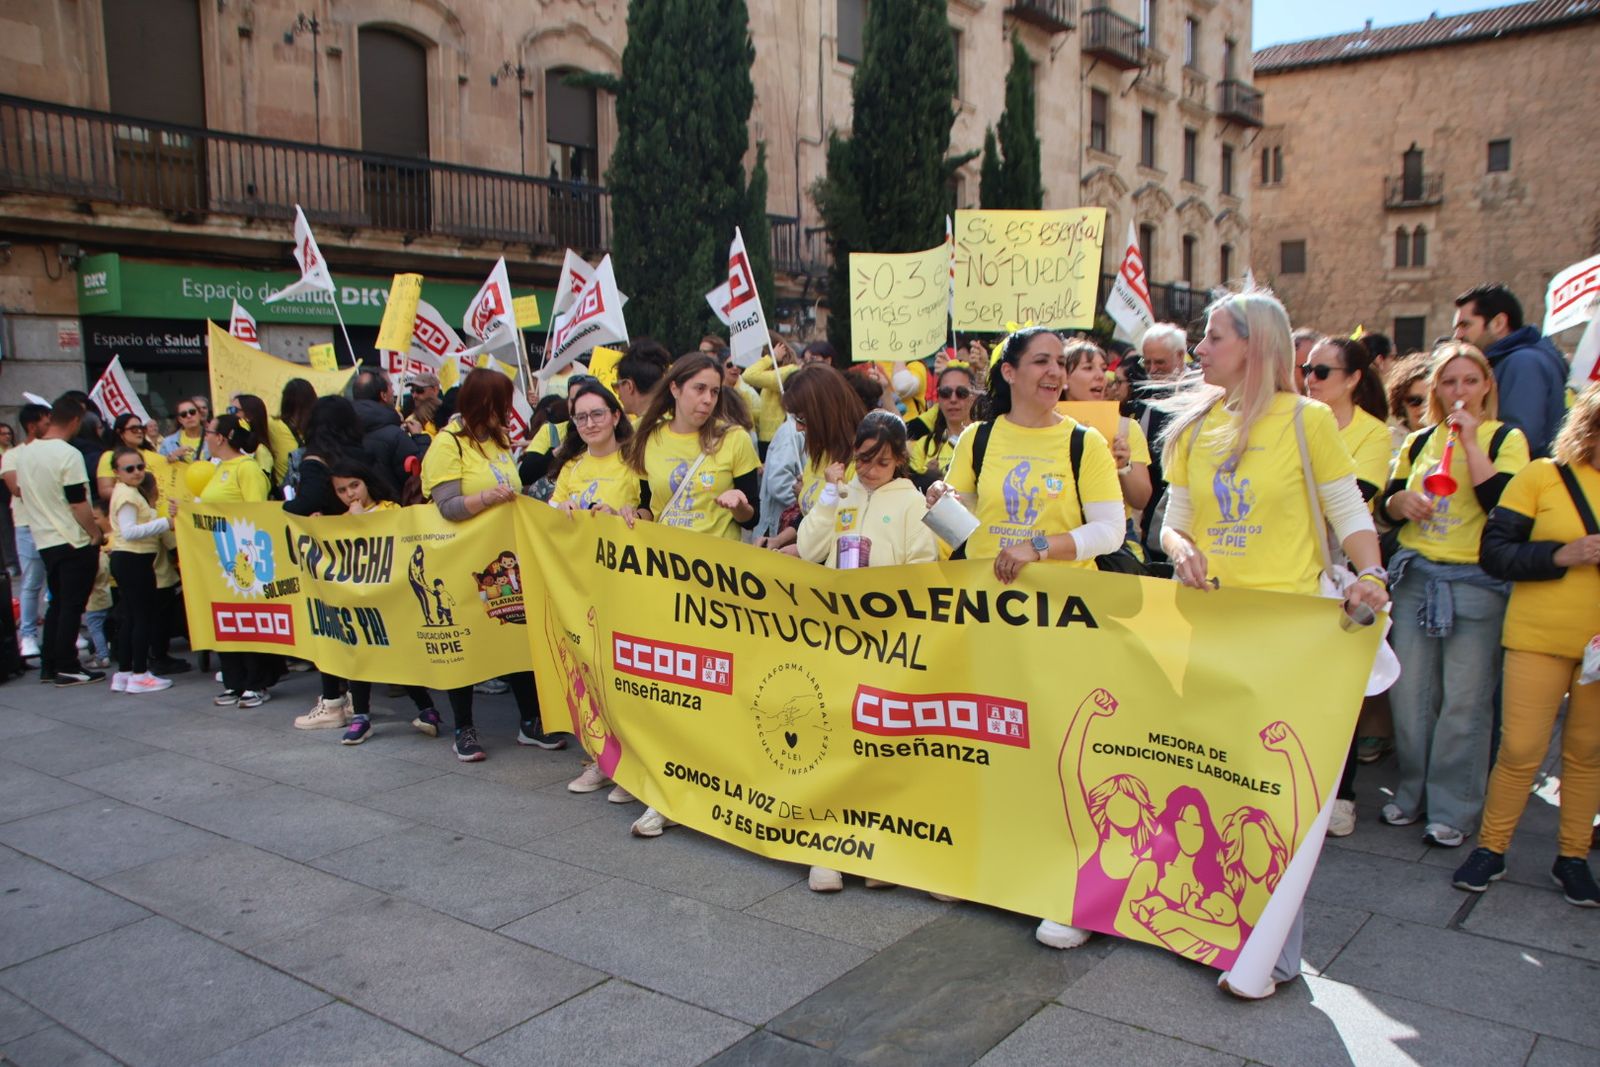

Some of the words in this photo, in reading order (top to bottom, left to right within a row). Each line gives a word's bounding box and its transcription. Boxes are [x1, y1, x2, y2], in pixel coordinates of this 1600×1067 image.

[83, 271, 107, 288] DKV
[182, 278, 253, 302] Espacio
[874, 261, 926, 299] 0-3
[270, 304, 303, 314] CENTRO
[94, 332, 144, 348] Espacio
[145, 332, 162, 347] de
[164, 333, 201, 347] Salud
[859, 328, 879, 351] de
[889, 330, 903, 351] lo
[1225, 534, 1246, 548] PIE
[322, 536, 394, 583] LUCHA
[595, 537, 766, 600] ABANDONO
[774, 579, 798, 606] Y
[810, 587, 1099, 629] VIOLENCIA
[216, 611, 290, 635] CCOO
[417, 630, 451, 641] EDUCACIÓN
[453, 628, 471, 638] 0-3
[674, 592, 927, 671] INSTITUCIONAL
[425, 642, 439, 655] EN
[440, 640, 463, 654] PIE
[615, 638, 697, 679] CCOO
[614, 676, 702, 711] enseñanza
[753, 663, 803, 707] PLATAFORMA
[806, 671, 829, 726] LABORAL
[856, 692, 979, 731] CCOO
[755, 715, 784, 770] ESCUELAS
[788, 735, 829, 775] INFANTILES
[853, 738, 990, 765] enseñanza
[1148, 732, 1205, 756] MEJORA
[1209, 747, 1227, 763] DE
[1092, 743, 1194, 770] CONDICIONES
[1197, 761, 1281, 796] LABORALES
[664, 761, 721, 792] SOMOS
[725, 780, 743, 801] LA
[748, 787, 777, 813] VOZ
[778, 801, 805, 820] DE
[809, 808, 838, 822] LA
[842, 808, 953, 845] INFANCIA
[711, 804, 732, 825] 0-3
[735, 815, 752, 835] ES
[755, 823, 875, 860] EDUCACIÓN
